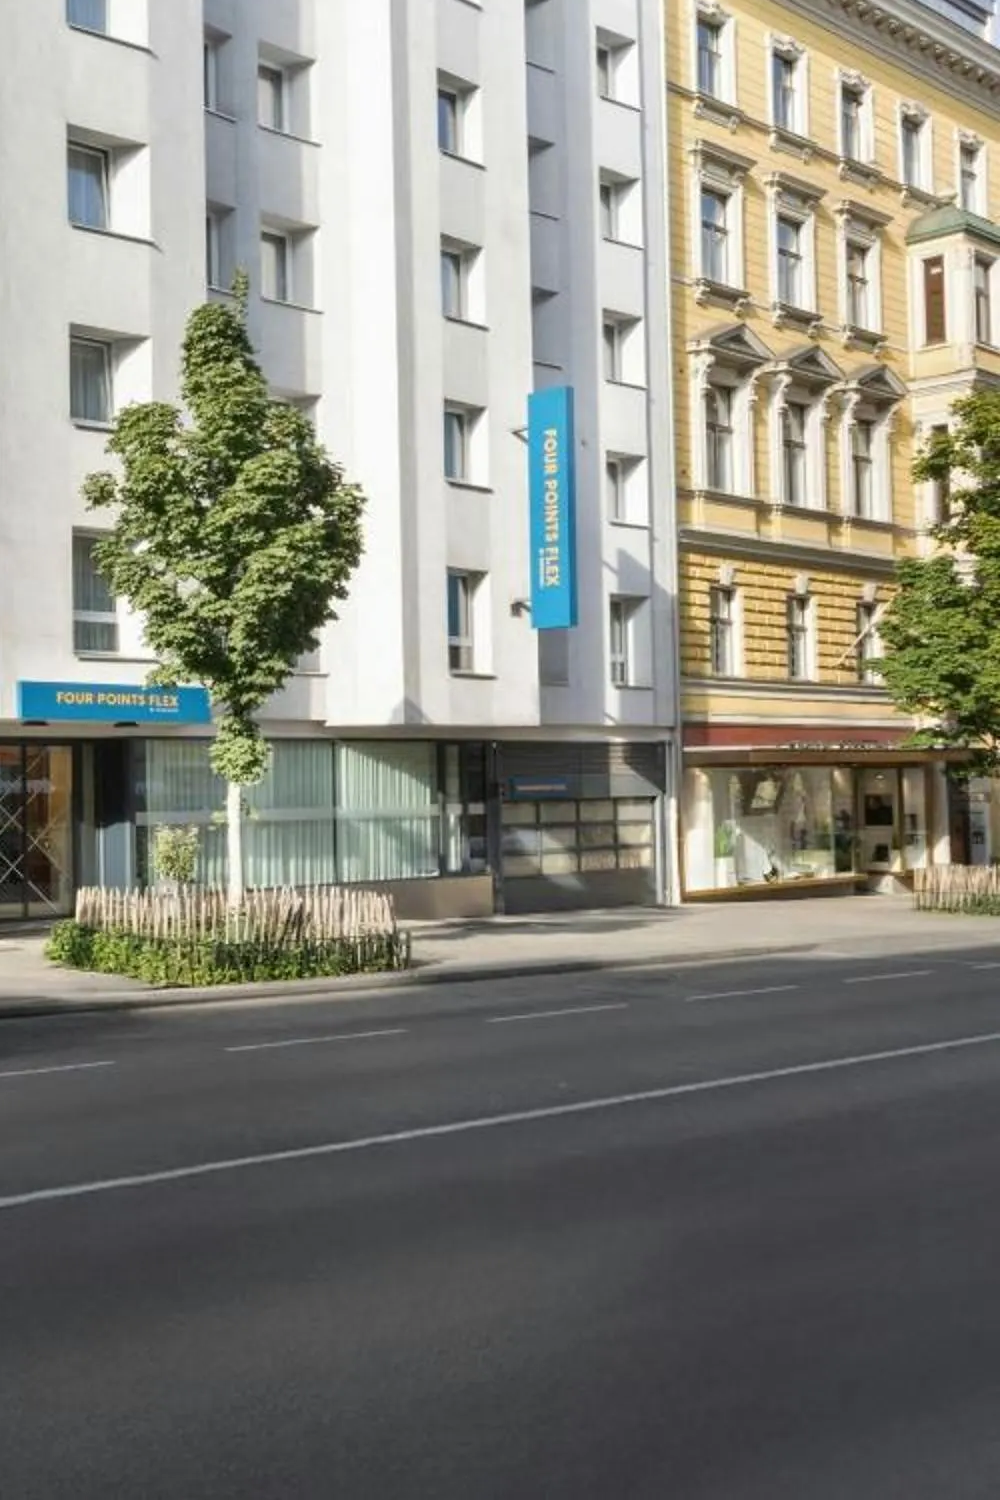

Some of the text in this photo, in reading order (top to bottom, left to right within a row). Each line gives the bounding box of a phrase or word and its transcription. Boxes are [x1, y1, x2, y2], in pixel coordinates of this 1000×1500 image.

[543, 428, 560, 586] FOUR POINTS FLEX
[56, 691, 178, 707] FOUR POINTS FLEX
